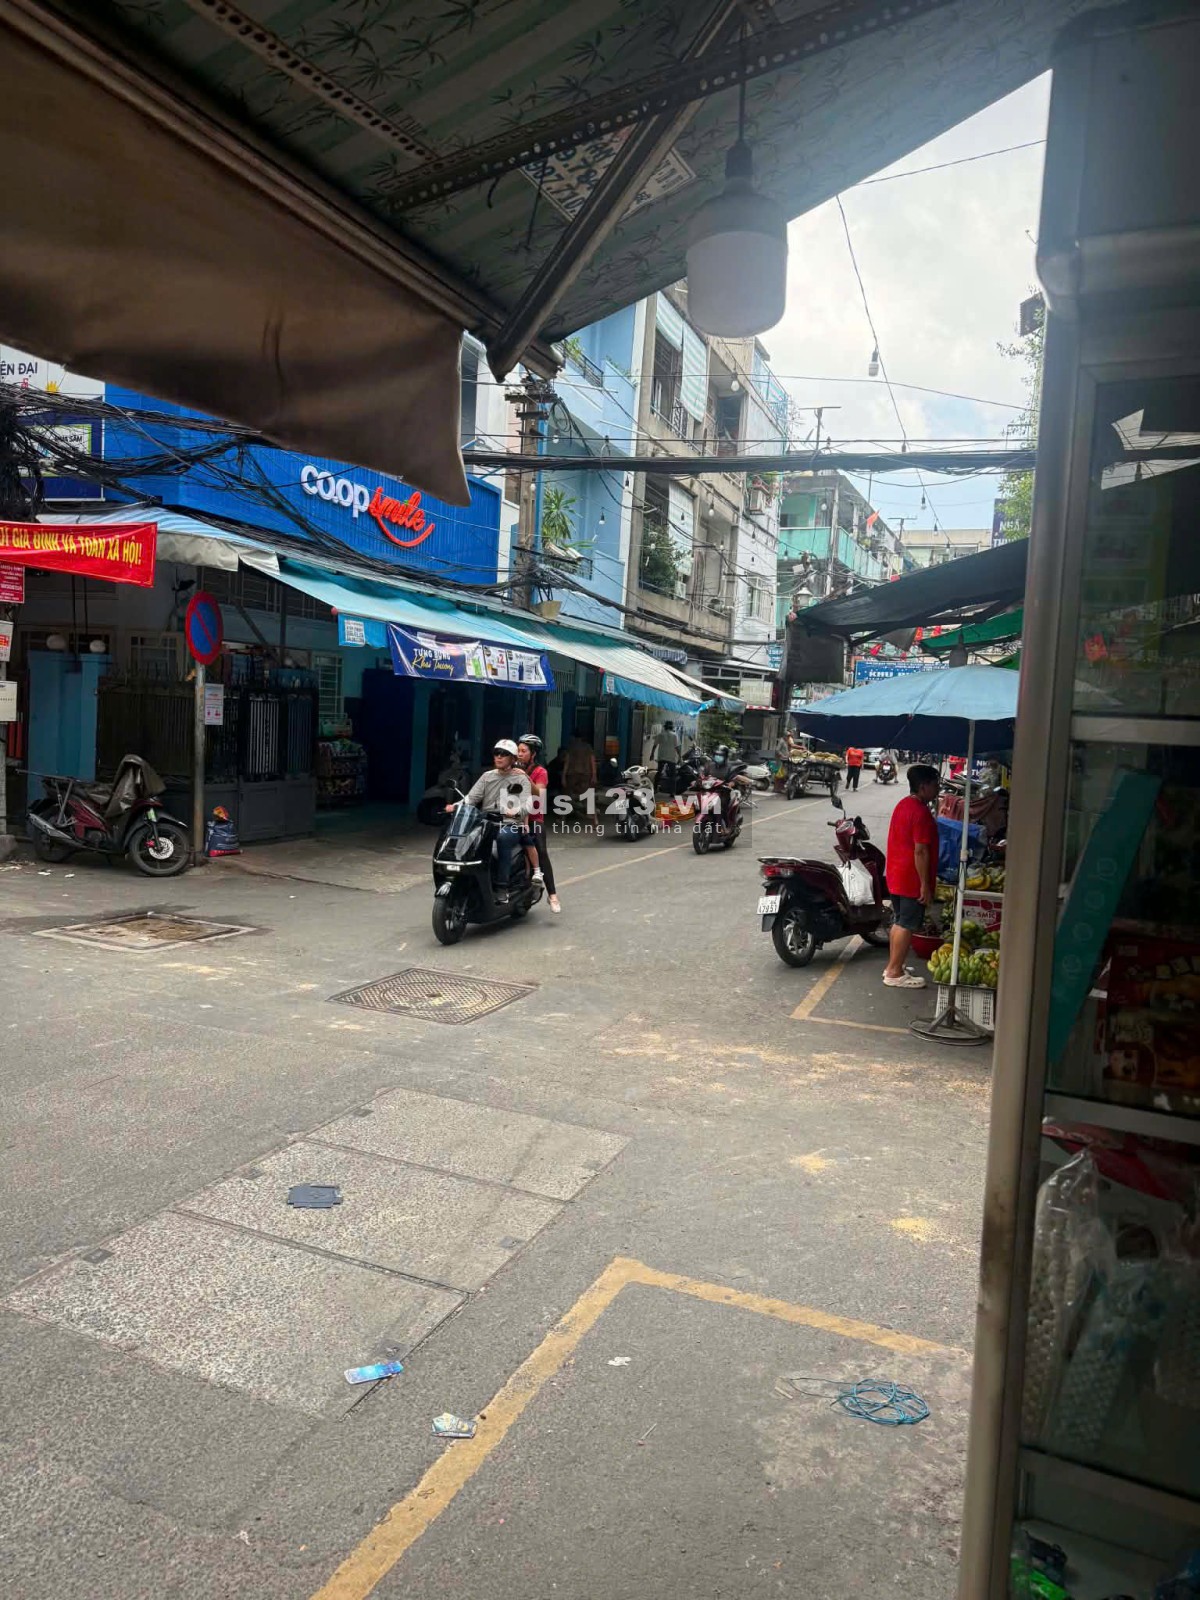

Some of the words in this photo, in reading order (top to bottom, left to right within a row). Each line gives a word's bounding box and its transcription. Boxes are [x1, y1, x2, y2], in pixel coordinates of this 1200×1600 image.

[18, 361, 38, 378] ĐẠI
[12, 527, 31, 549] GIA
[106, 534, 120, 562] XÃ
